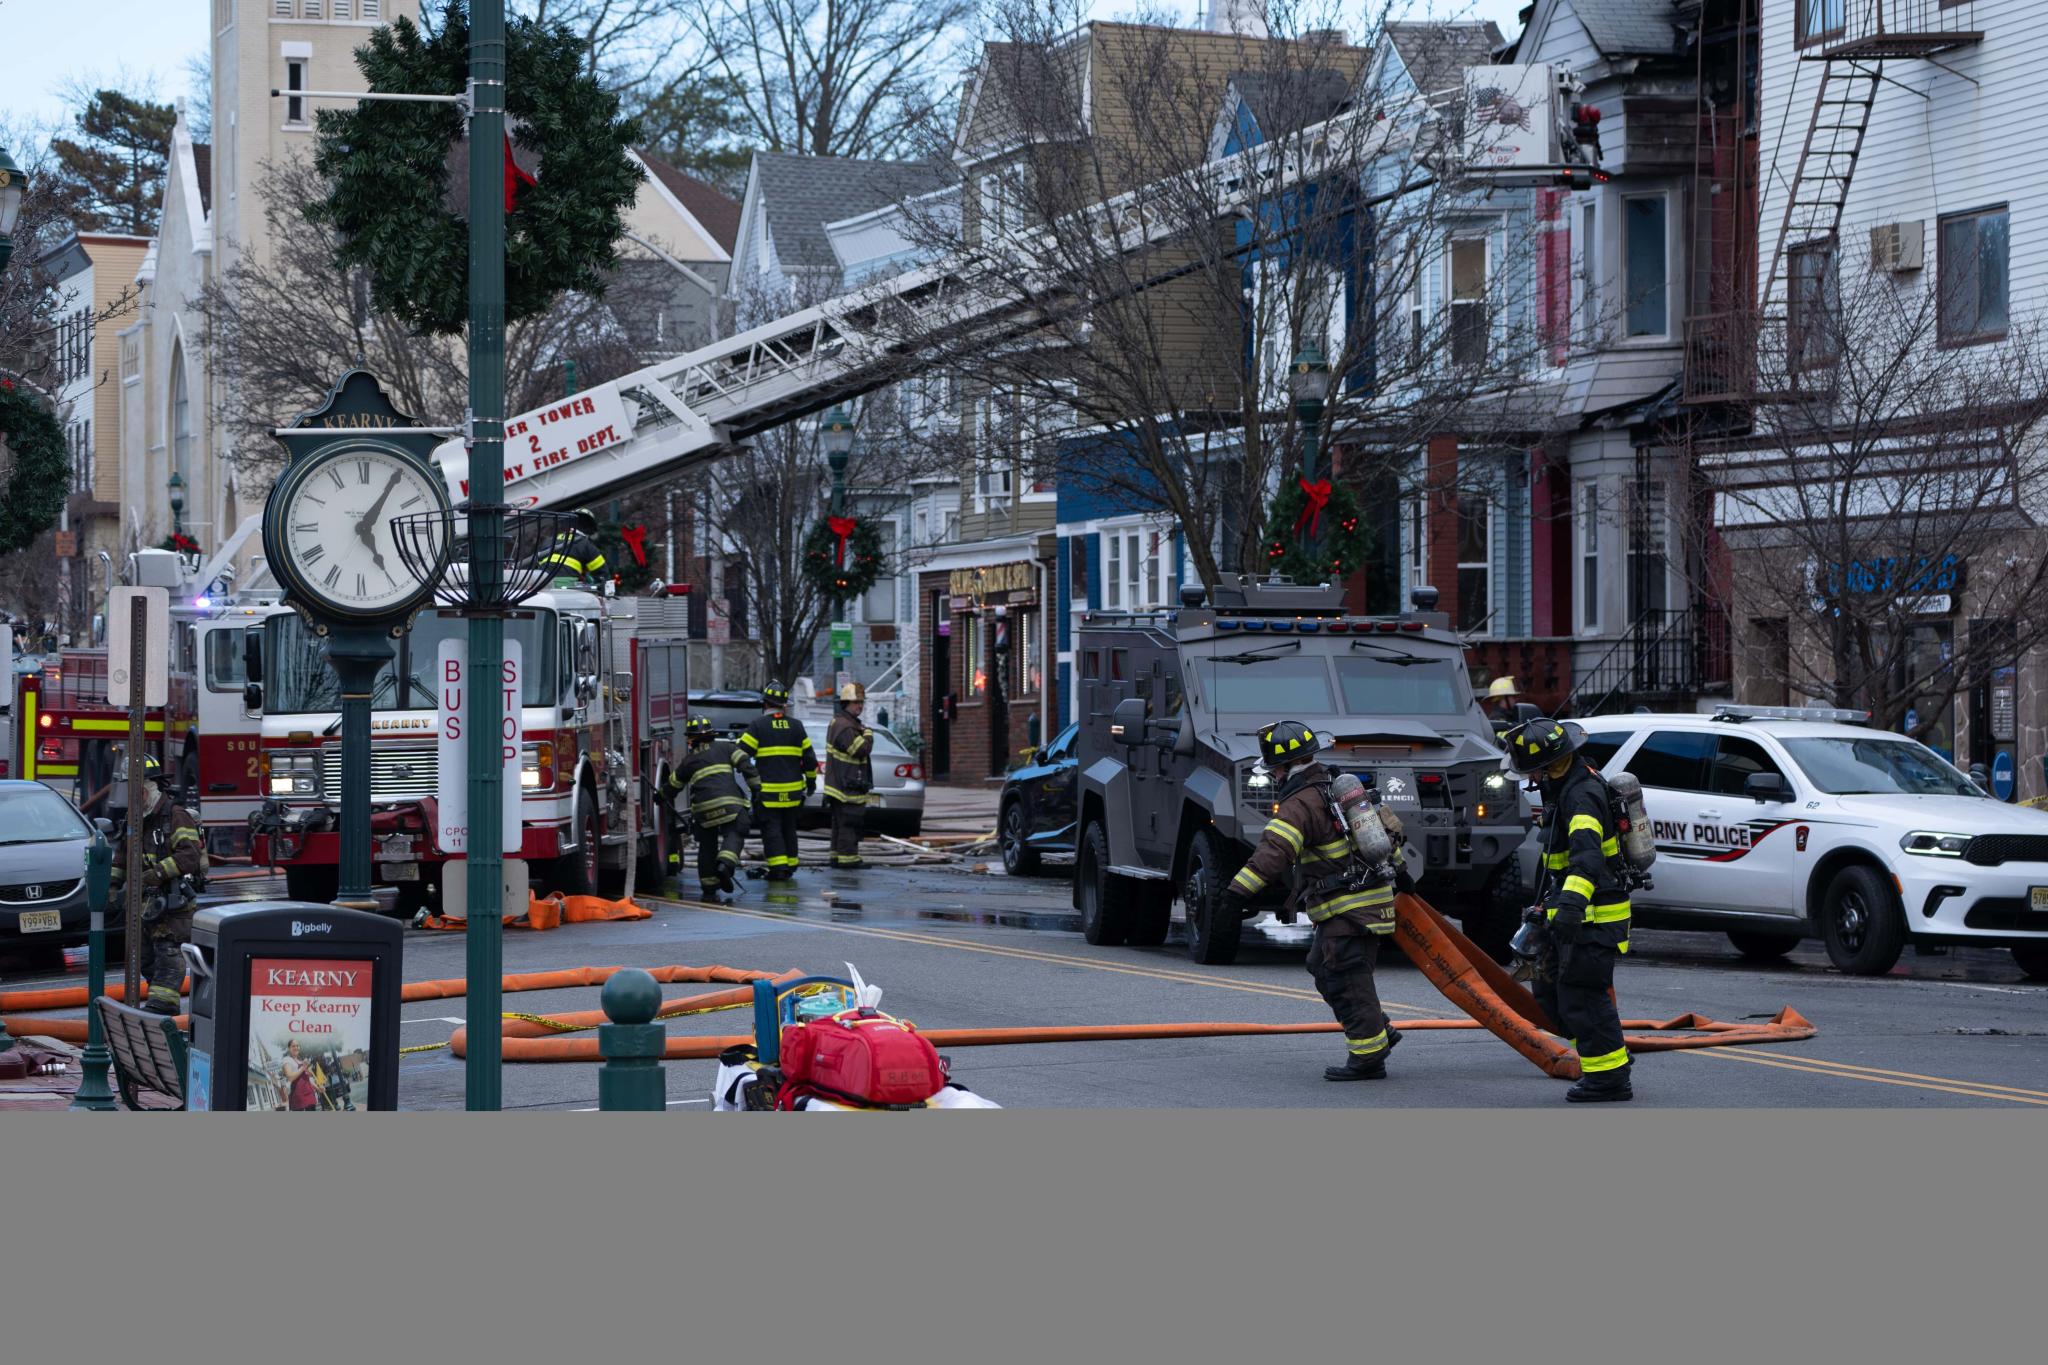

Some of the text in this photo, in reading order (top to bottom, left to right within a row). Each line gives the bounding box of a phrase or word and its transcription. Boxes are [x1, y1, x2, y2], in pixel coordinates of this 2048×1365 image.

[537, 397, 596, 426] TOWER
[528, 434, 541, 453] 2
[533, 447, 569, 471] FIRE
[577, 425, 622, 454] DEPT.
[445, 660, 461, 740] BUS
[371, 719, 431, 730] KEARNY
[502, 660, 517, 769] STOP
[247, 757, 258, 778] 2
[1805, 801, 1820, 810] 62
[1693, 823, 1750, 847] POLICE
[291, 920, 332, 937] Bigbelly
[267, 968, 358, 988] KEARNY
[262, 999, 361, 1018] Keep Kearny
[288, 1019, 333, 1034] Clean
